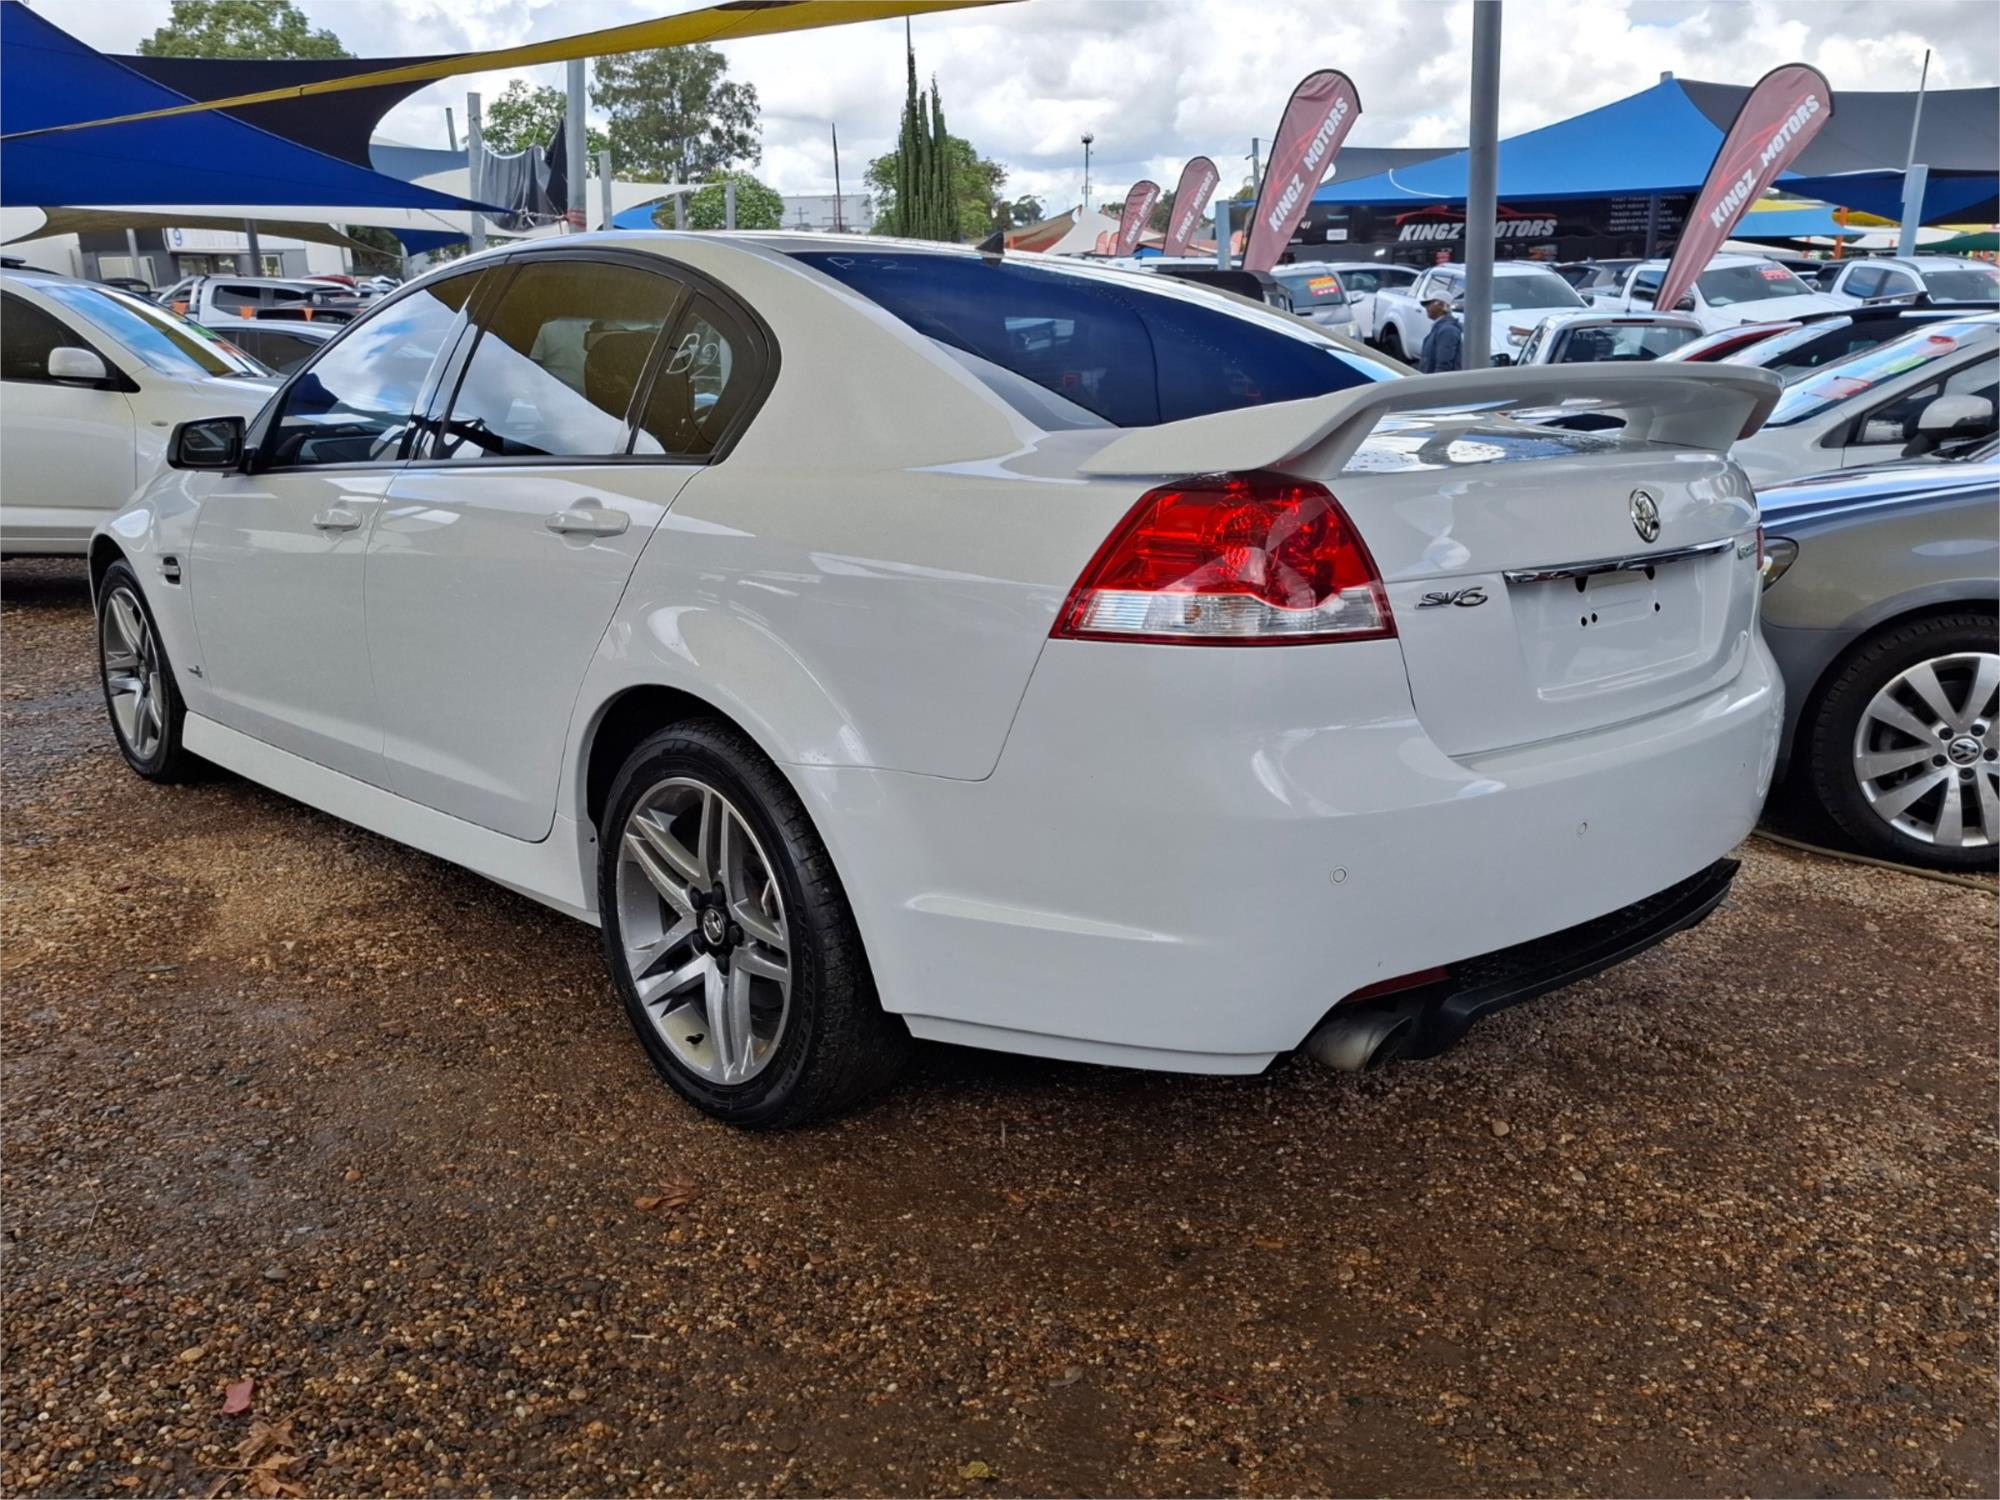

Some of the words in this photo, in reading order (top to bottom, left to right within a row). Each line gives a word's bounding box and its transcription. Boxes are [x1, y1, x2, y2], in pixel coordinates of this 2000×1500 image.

[1269, 174, 1305, 232] KINGZ
[1303, 97, 1348, 172] MOTORS
[1710, 168, 1757, 229] KINGZ
[1760, 94, 1820, 167] MOTORS
[1398, 222, 1465, 242] KINGZ
[1493, 219, 1558, 239] OTORS
[1414, 586, 1489, 610] SV6
